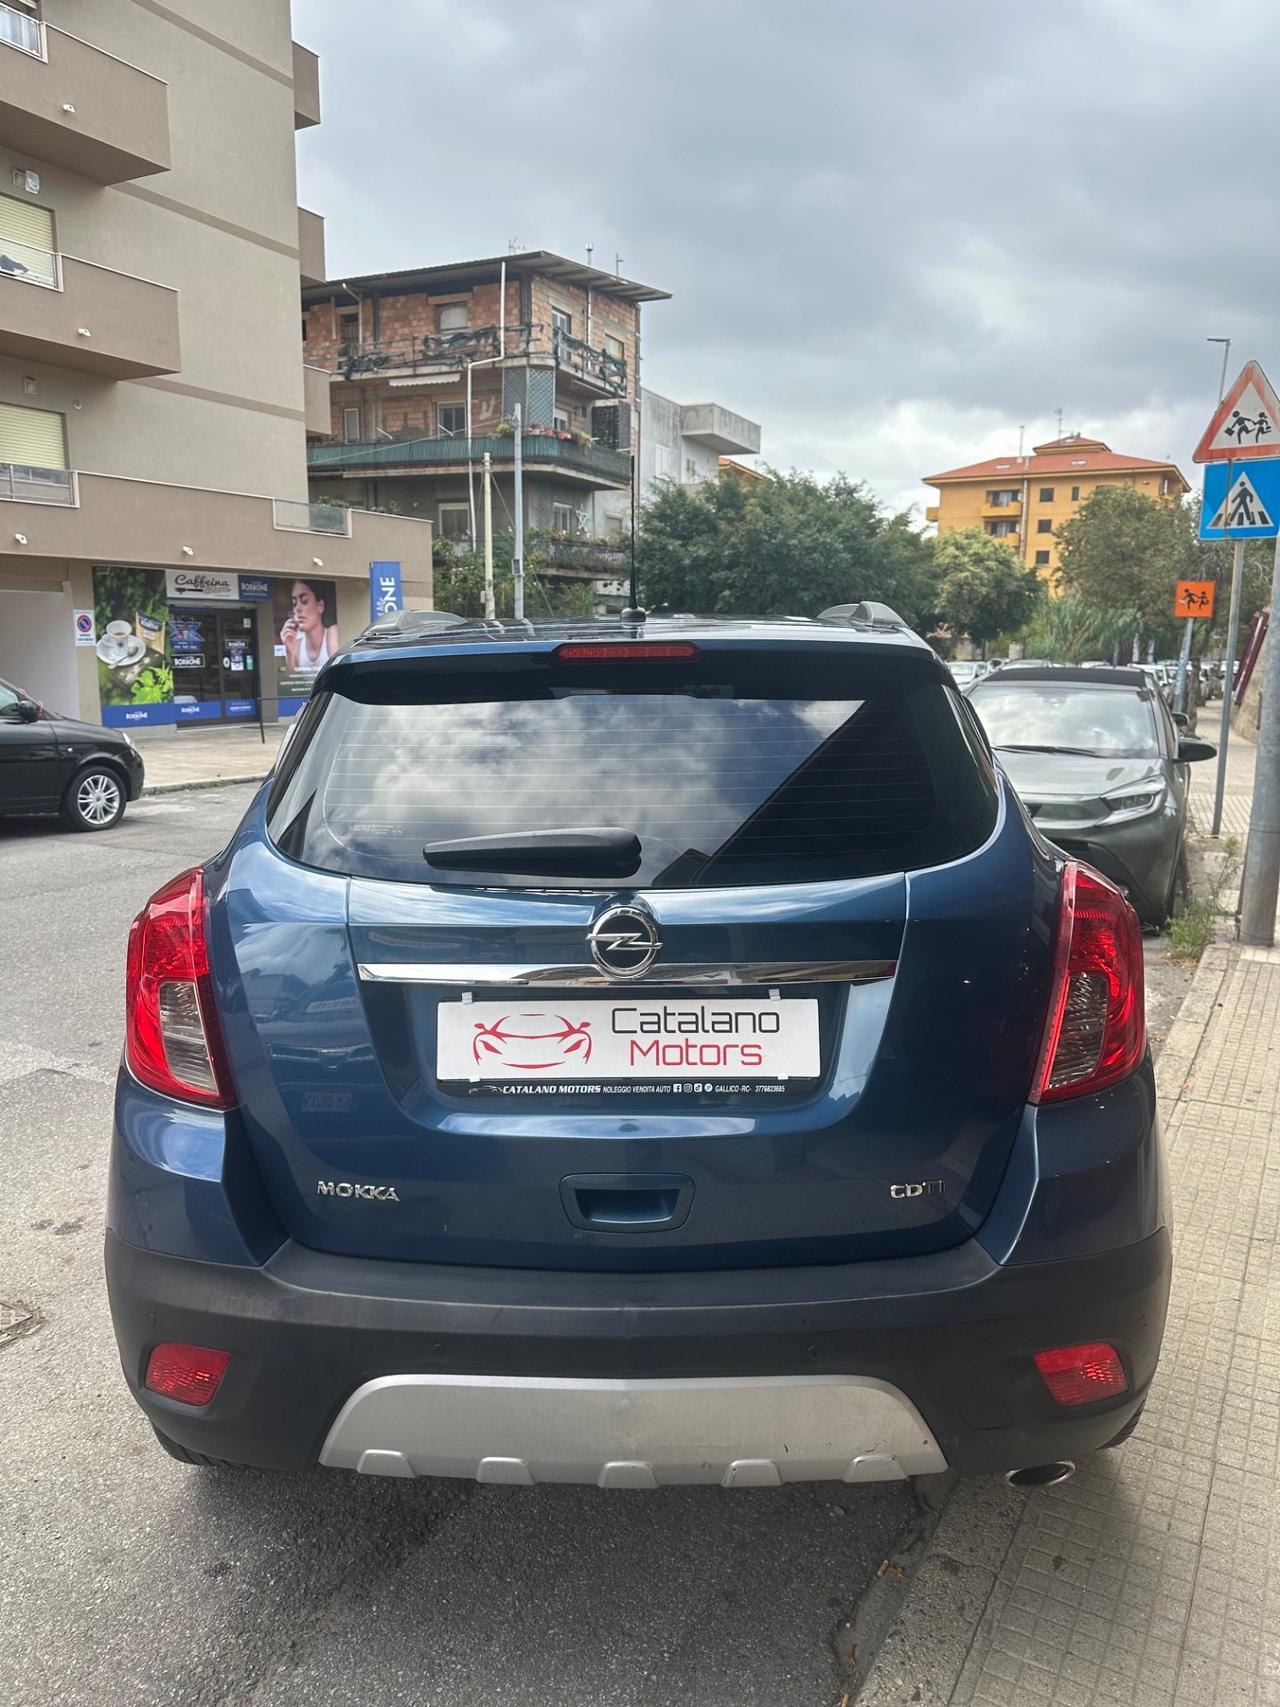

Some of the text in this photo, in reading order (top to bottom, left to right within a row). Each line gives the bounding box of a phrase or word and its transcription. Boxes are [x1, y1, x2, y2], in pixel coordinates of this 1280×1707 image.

[174, 574, 230, 588] Caffeina
[611, 1005, 780, 1034] Catalano
[630, 1038, 762, 1066] Motors
[502, 1085, 557, 1094] CATALANO
[558, 1085, 601, 1094] MOTORS
[602, 1085, 631, 1094] NOLEGGIO
[632, 1085, 655, 1093] VENDITA
[655, 1085, 671, 1093] AUTO
[714, 1085, 740, 1093] GALLICO
[317, 1180, 400, 1202] MOKKA
